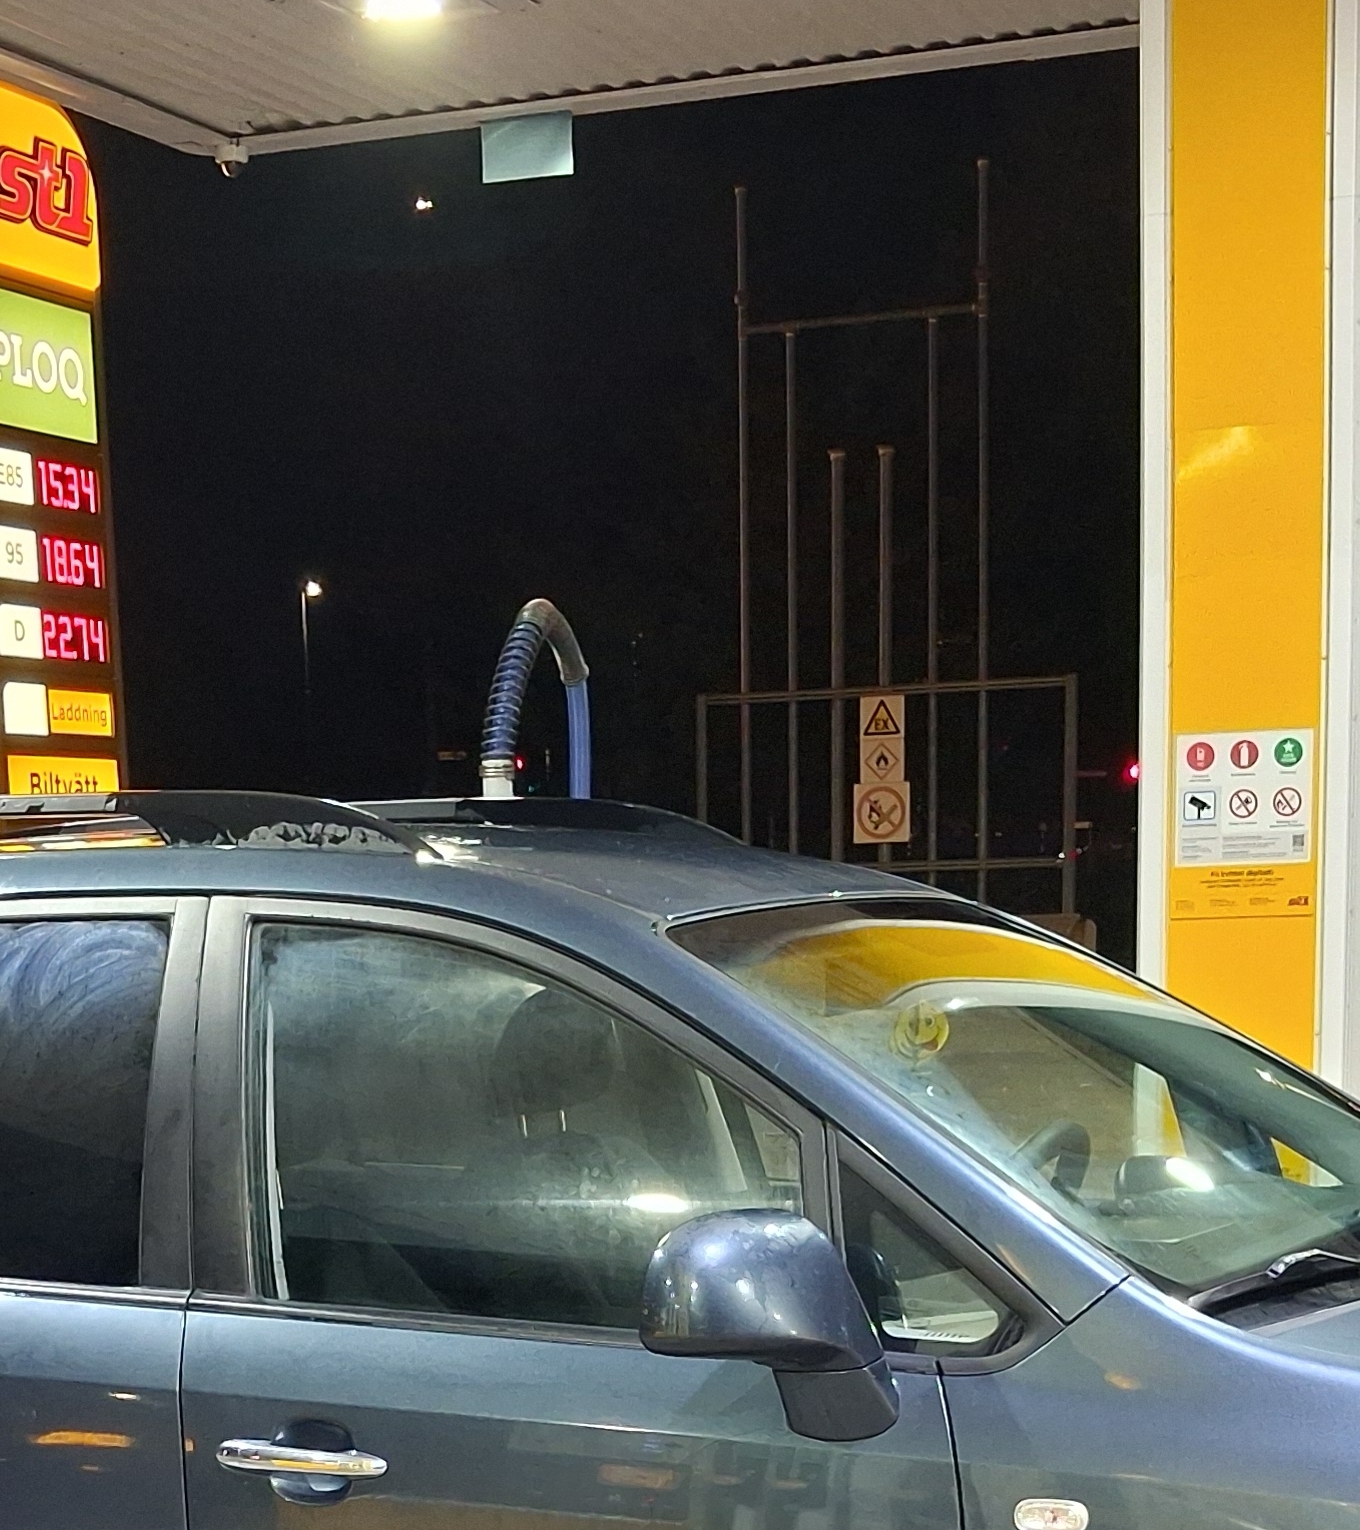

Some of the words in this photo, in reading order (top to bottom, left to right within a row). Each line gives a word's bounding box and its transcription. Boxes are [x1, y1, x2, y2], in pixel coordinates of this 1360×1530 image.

[5, 541, 24, 566] 95
[14, 619, 26, 642] D
[51, 703, 108, 728] Laddning
[873, 717, 890, 732] EX
